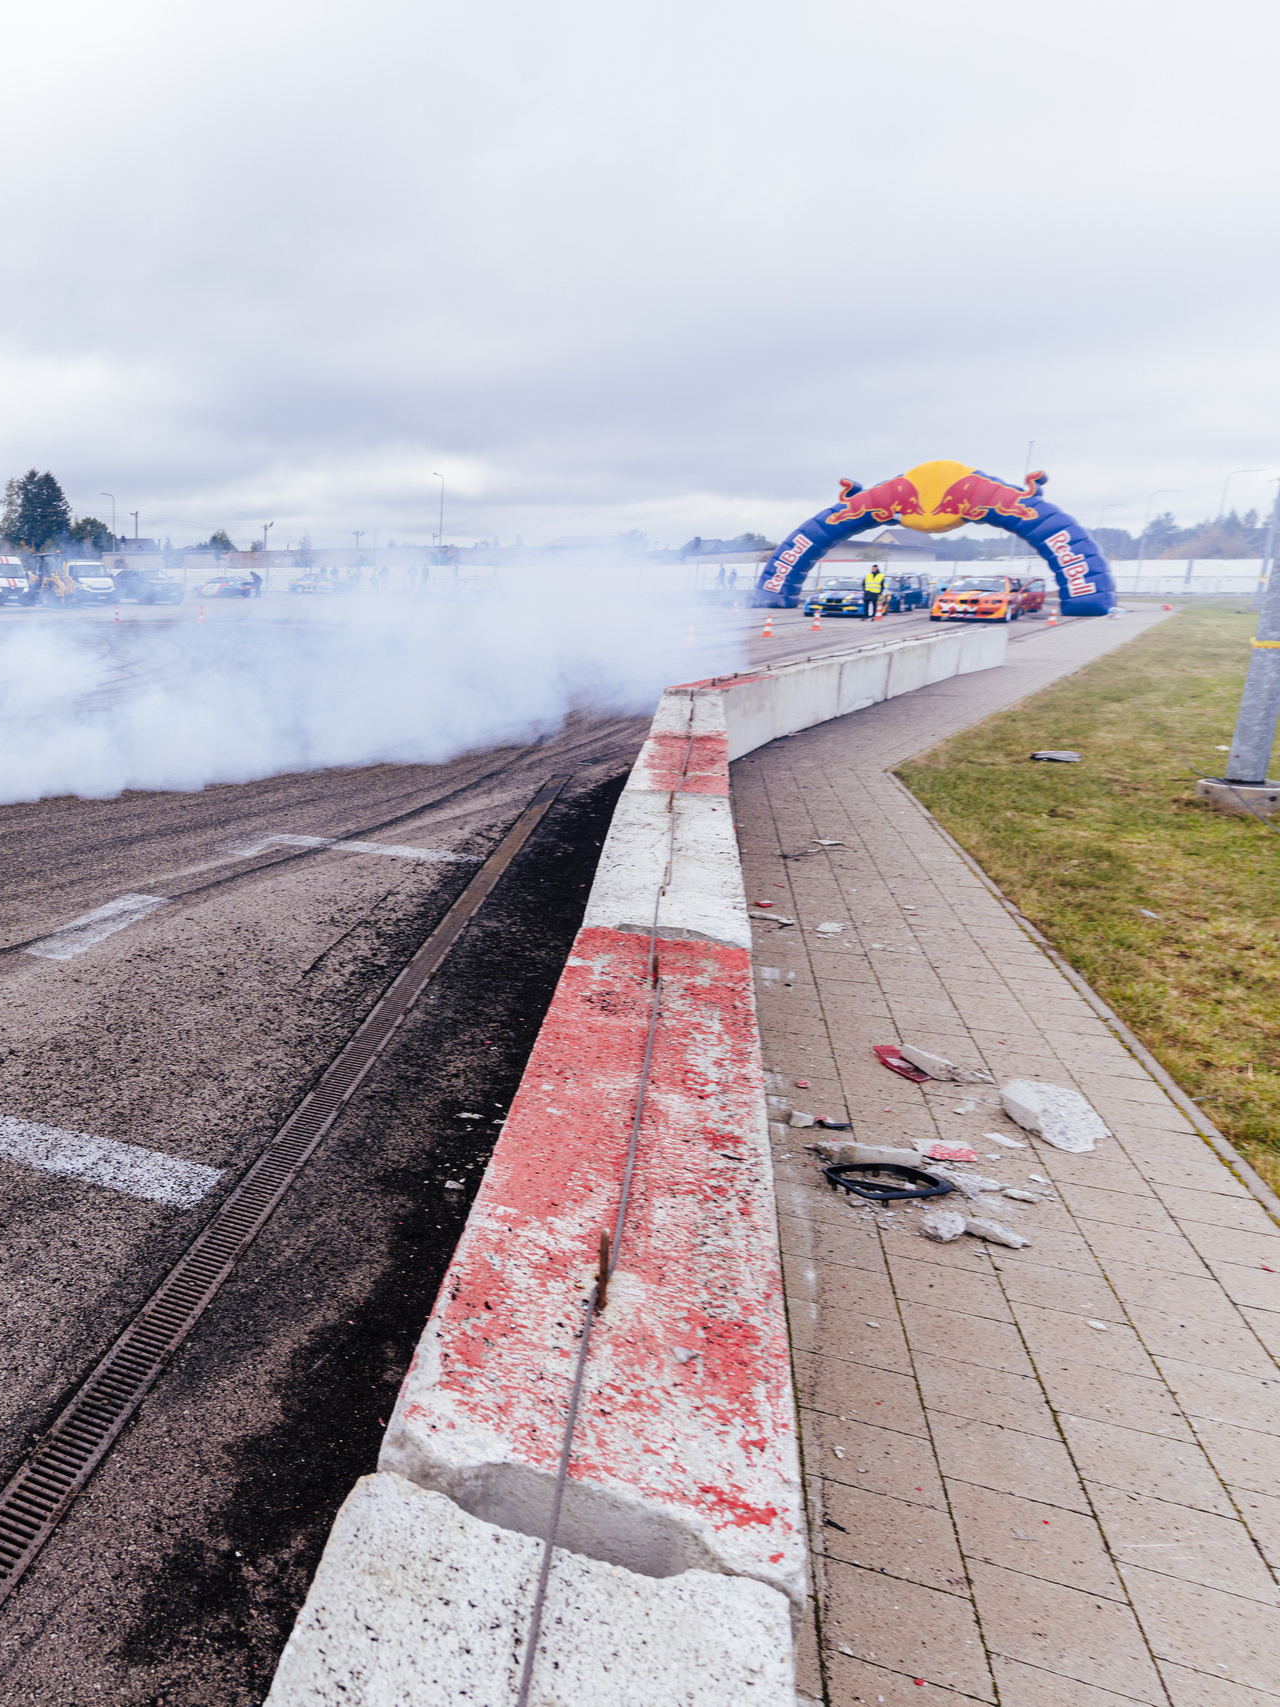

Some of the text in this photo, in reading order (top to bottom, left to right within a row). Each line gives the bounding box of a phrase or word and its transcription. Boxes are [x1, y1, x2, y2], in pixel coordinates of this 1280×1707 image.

[764, 534, 812, 592] Red Bull
[1045, 530, 1096, 597] Red Bull
